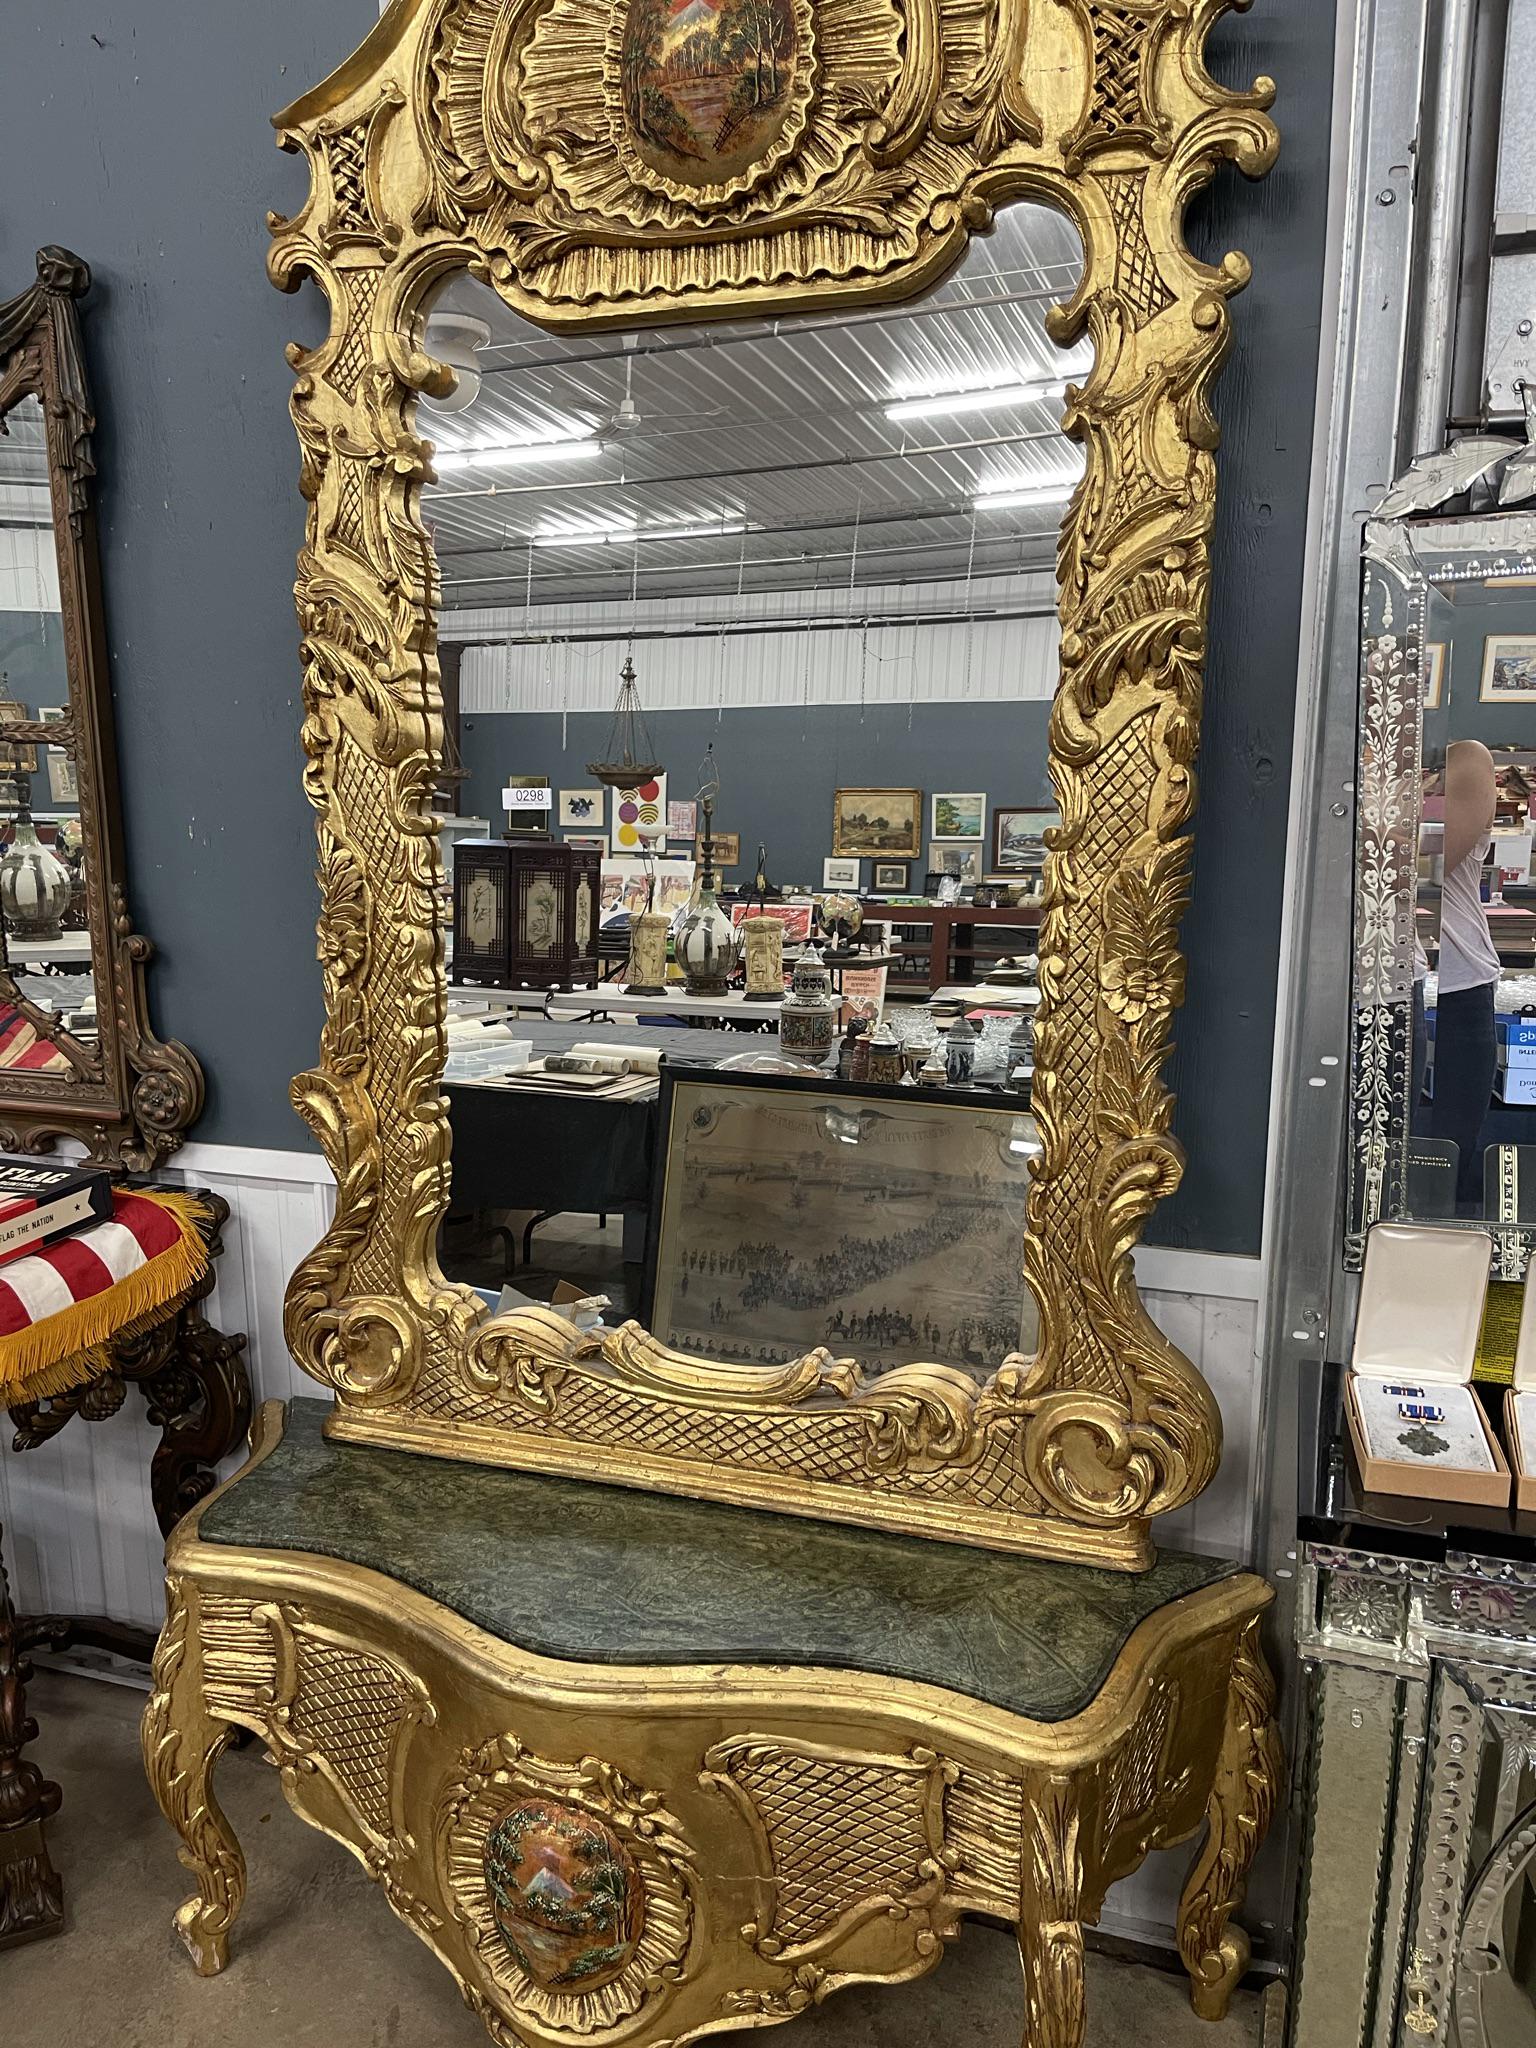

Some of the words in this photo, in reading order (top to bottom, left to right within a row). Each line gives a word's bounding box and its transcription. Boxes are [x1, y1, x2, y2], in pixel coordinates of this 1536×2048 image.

[516, 789, 544, 801] 0298
[0, 1167, 71, 1184] FLAG
[17, 1223, 30, 1235] THE
[32, 1214, 54, 1229] NATION
